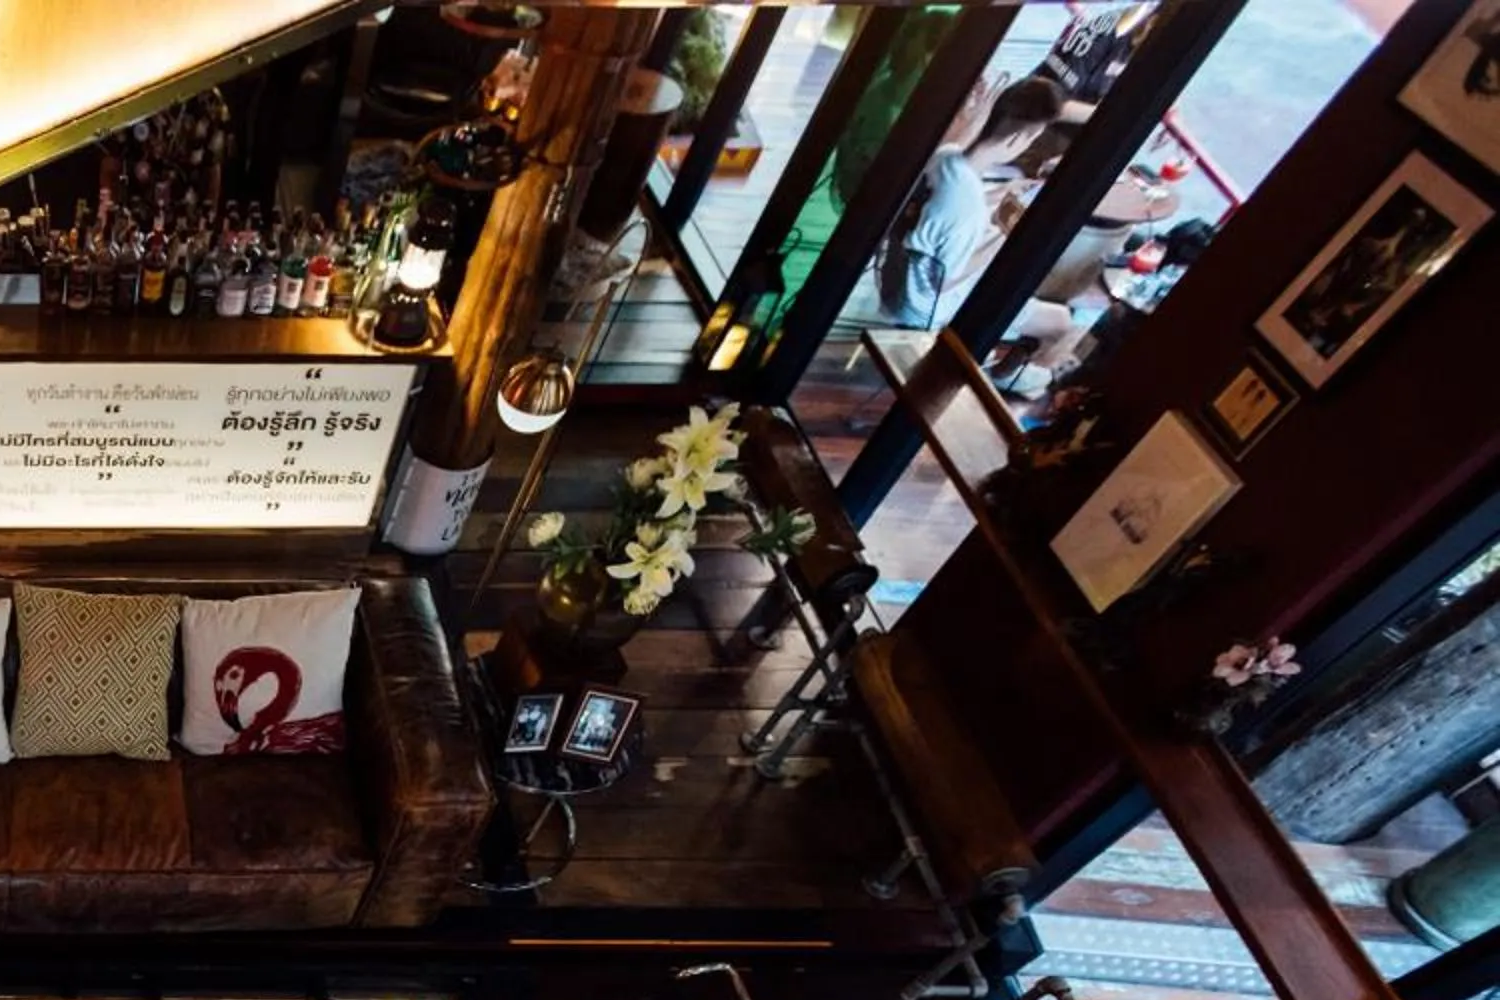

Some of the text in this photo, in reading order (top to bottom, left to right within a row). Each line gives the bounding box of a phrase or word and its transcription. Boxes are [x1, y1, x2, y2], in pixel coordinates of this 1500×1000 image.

[222, 411, 382, 437] ต้องรู้ลึก รู้จริง
